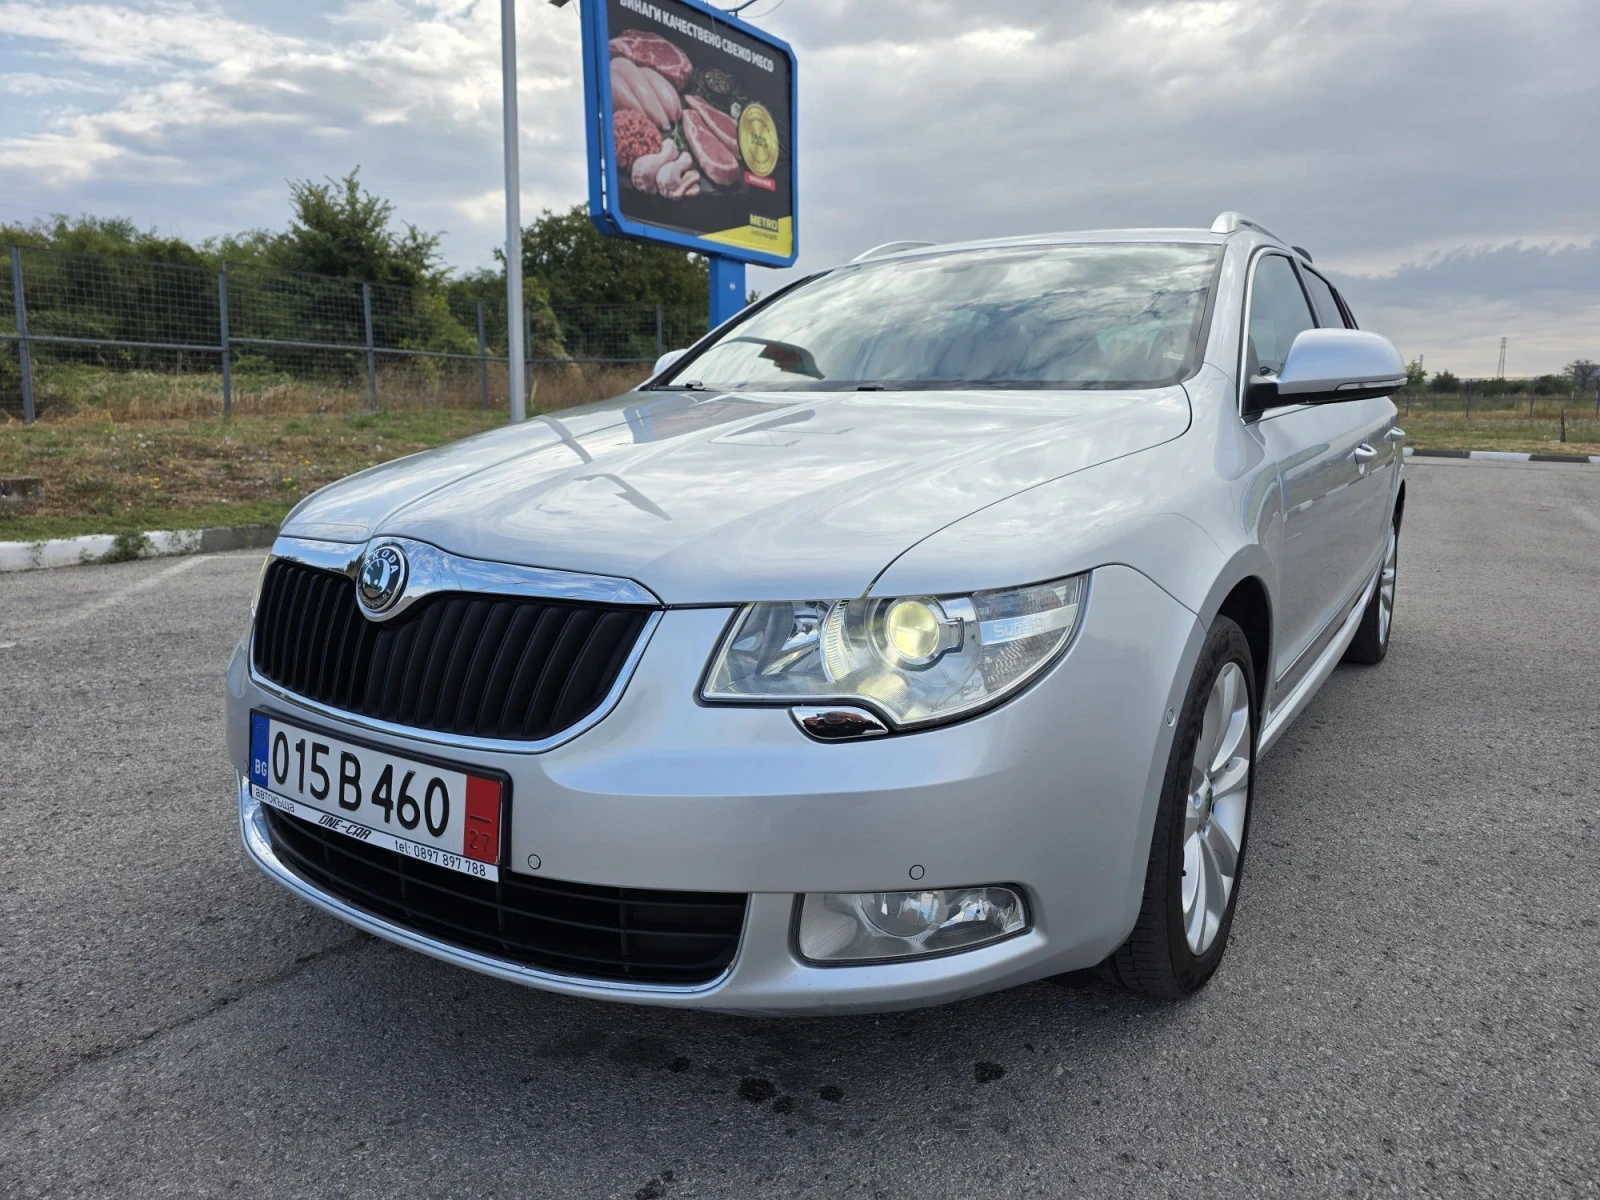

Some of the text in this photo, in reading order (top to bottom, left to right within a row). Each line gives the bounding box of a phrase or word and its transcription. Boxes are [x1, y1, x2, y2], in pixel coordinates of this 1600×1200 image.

[662, 10, 721, 49] КАЧЕСТВЕНО
[722, 38, 751, 62] СВЕЖО
[752, 52, 774, 73] МЕСО
[750, 213, 778, 231] METRO
[254, 758, 268, 777] BG
[255, 787, 295, 813] автокъща
[318, 814, 372, 841] ONE-CAR
[469, 829, 491, 854] 27
[395, 839, 486, 877] tel: 0897 897 788
